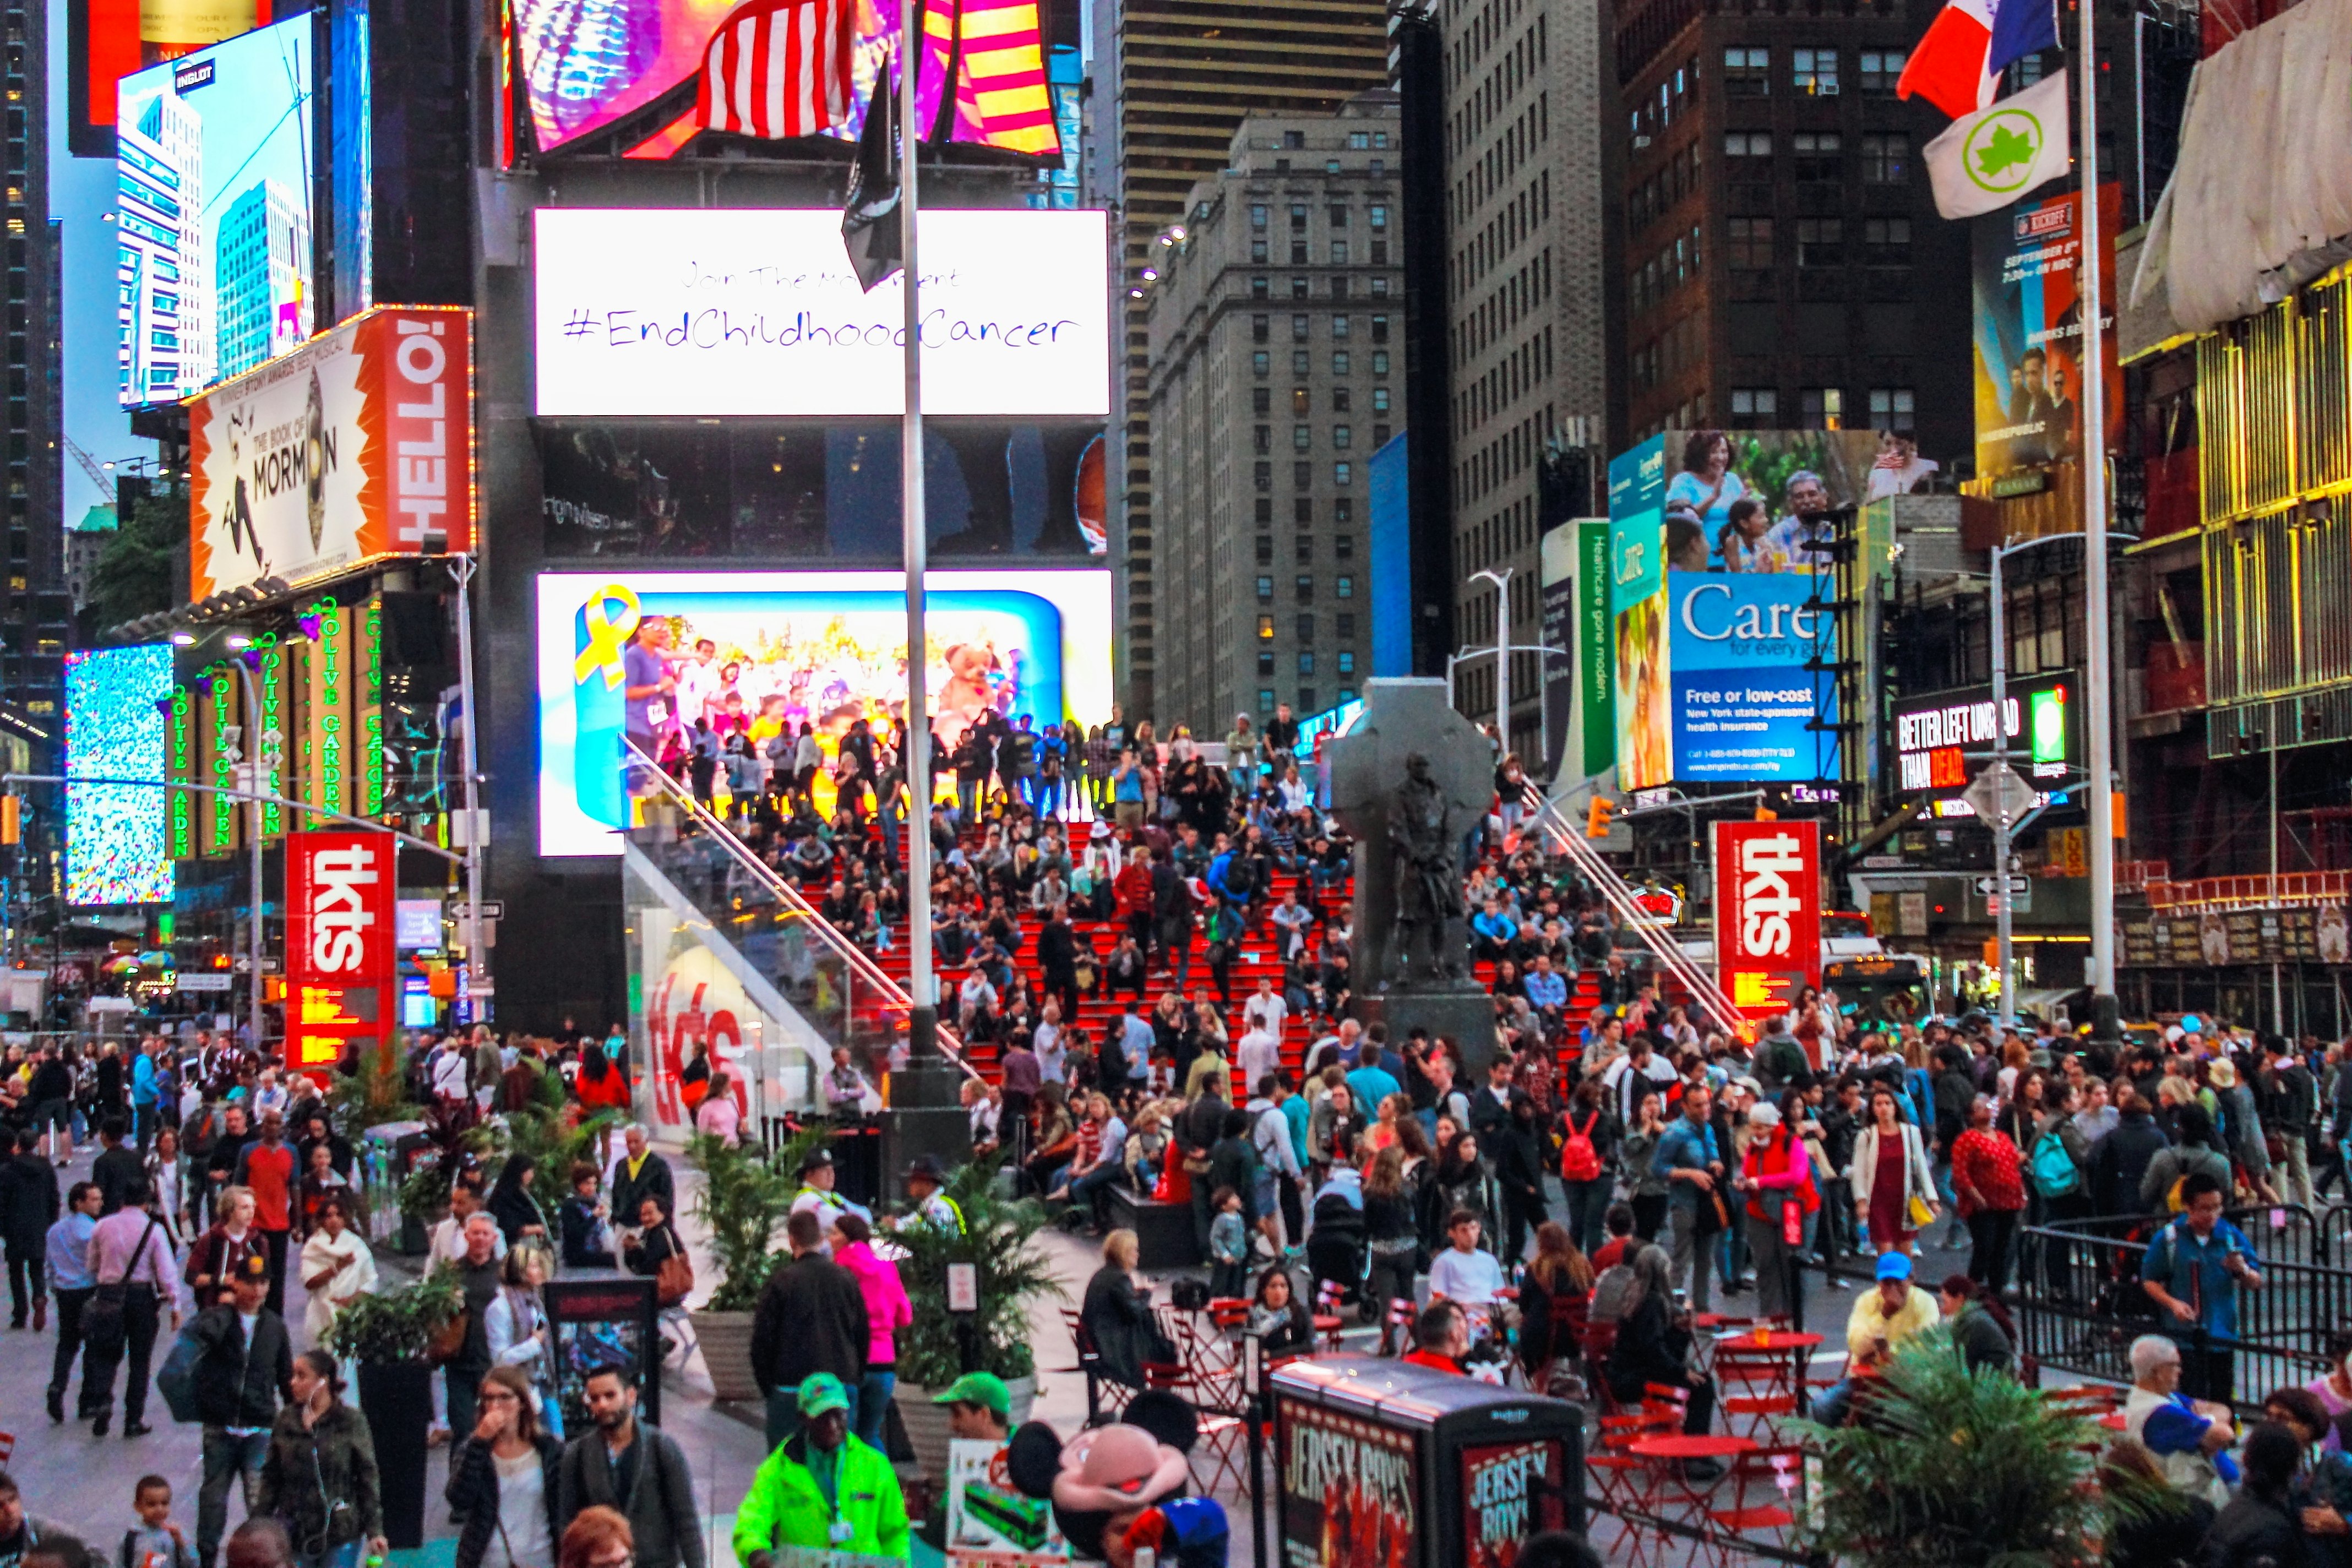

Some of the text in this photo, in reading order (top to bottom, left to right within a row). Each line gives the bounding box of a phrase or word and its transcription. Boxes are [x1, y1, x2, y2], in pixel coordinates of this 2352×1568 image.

[176, 65, 213, 89] INGLOT
[2030, 210, 2065, 230] KICKOFF
[680, 260, 737, 288] Join
[749, 266, 806, 289] The
[2003, 244, 2064, 269] SEPTEMBER
[268, 360, 295, 384] AWARDS
[253, 416, 307, 455] THE BOOK OF
[397, 319, 447, 542] HELLO!
[1592, 535, 1609, 703] Healthcare gone modern.
[1681, 583, 1820, 641] Care
[1730, 640, 1750, 656] for
[1755, 642, 1797, 659] every
[213, 678, 230, 752] OLIVE
[262, 652, 280, 731] OLIVE
[320, 618, 341, 819] OLIVE GARDEN
[1685, 687, 1813, 704] Free or low-cost
[1686, 706, 1815, 718] New York state-sponsored
[172, 701, 189, 769] OLIVE
[1686, 721, 1769, 732] health insurance
[1899, 696, 2021, 752] BETTER LEFT UNRAD
[1900, 752, 1931, 790] THAN
[313, 843, 379, 973] tkts
[1741, 832, 1804, 957] tkts
[1284, 1423, 1357, 1504] JERSEY
[1469, 1450, 1548, 1509] JERSEY
